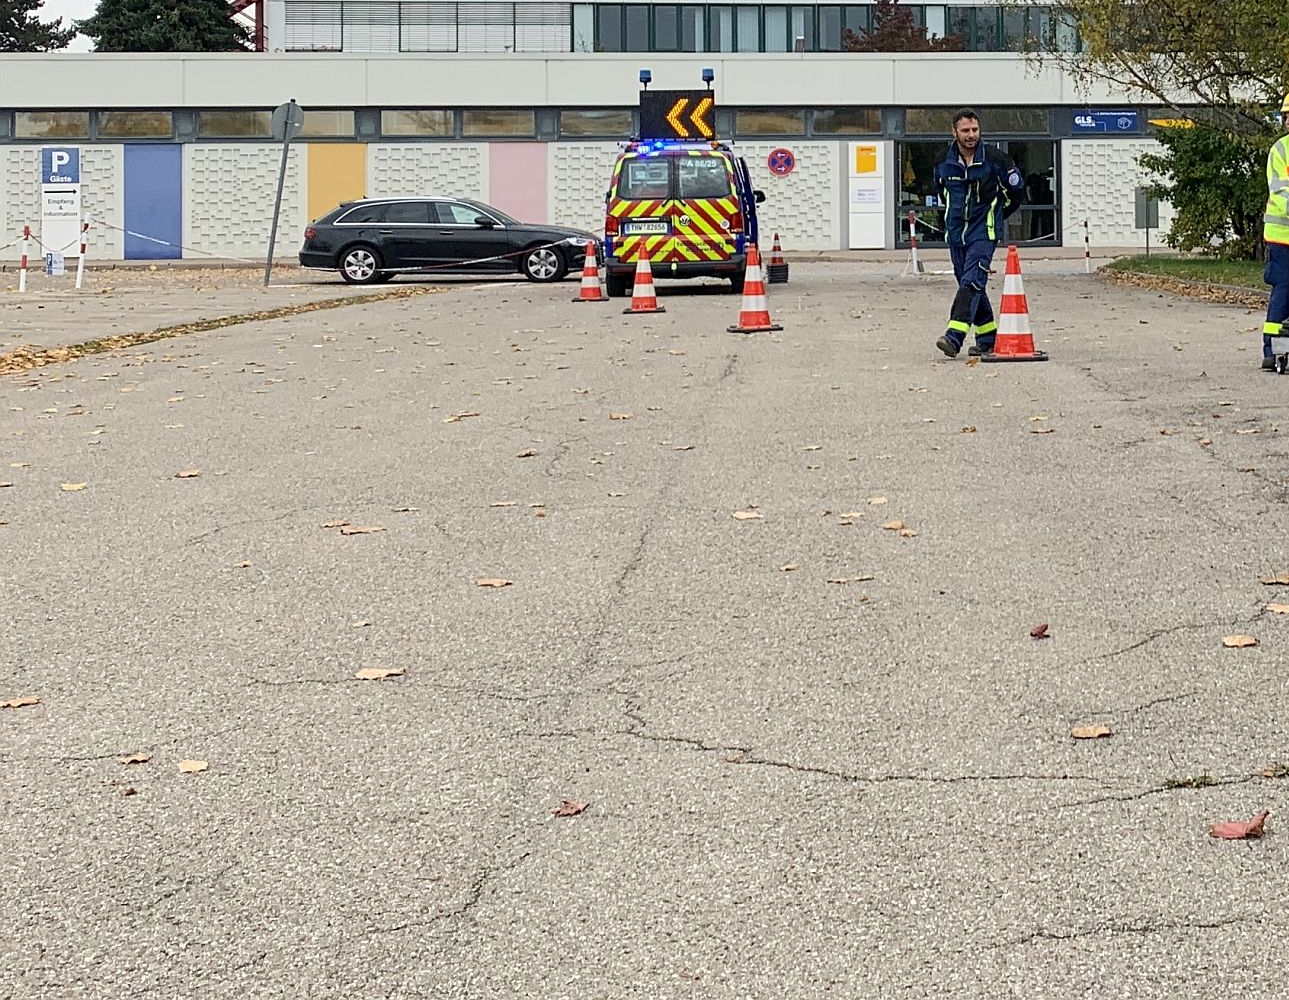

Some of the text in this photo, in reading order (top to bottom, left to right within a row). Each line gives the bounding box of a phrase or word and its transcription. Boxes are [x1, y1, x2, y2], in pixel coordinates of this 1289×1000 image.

[1074, 116, 1093, 125] GLS
[51, 151, 70, 173] P
[50, 175, 72, 183] Gäste
